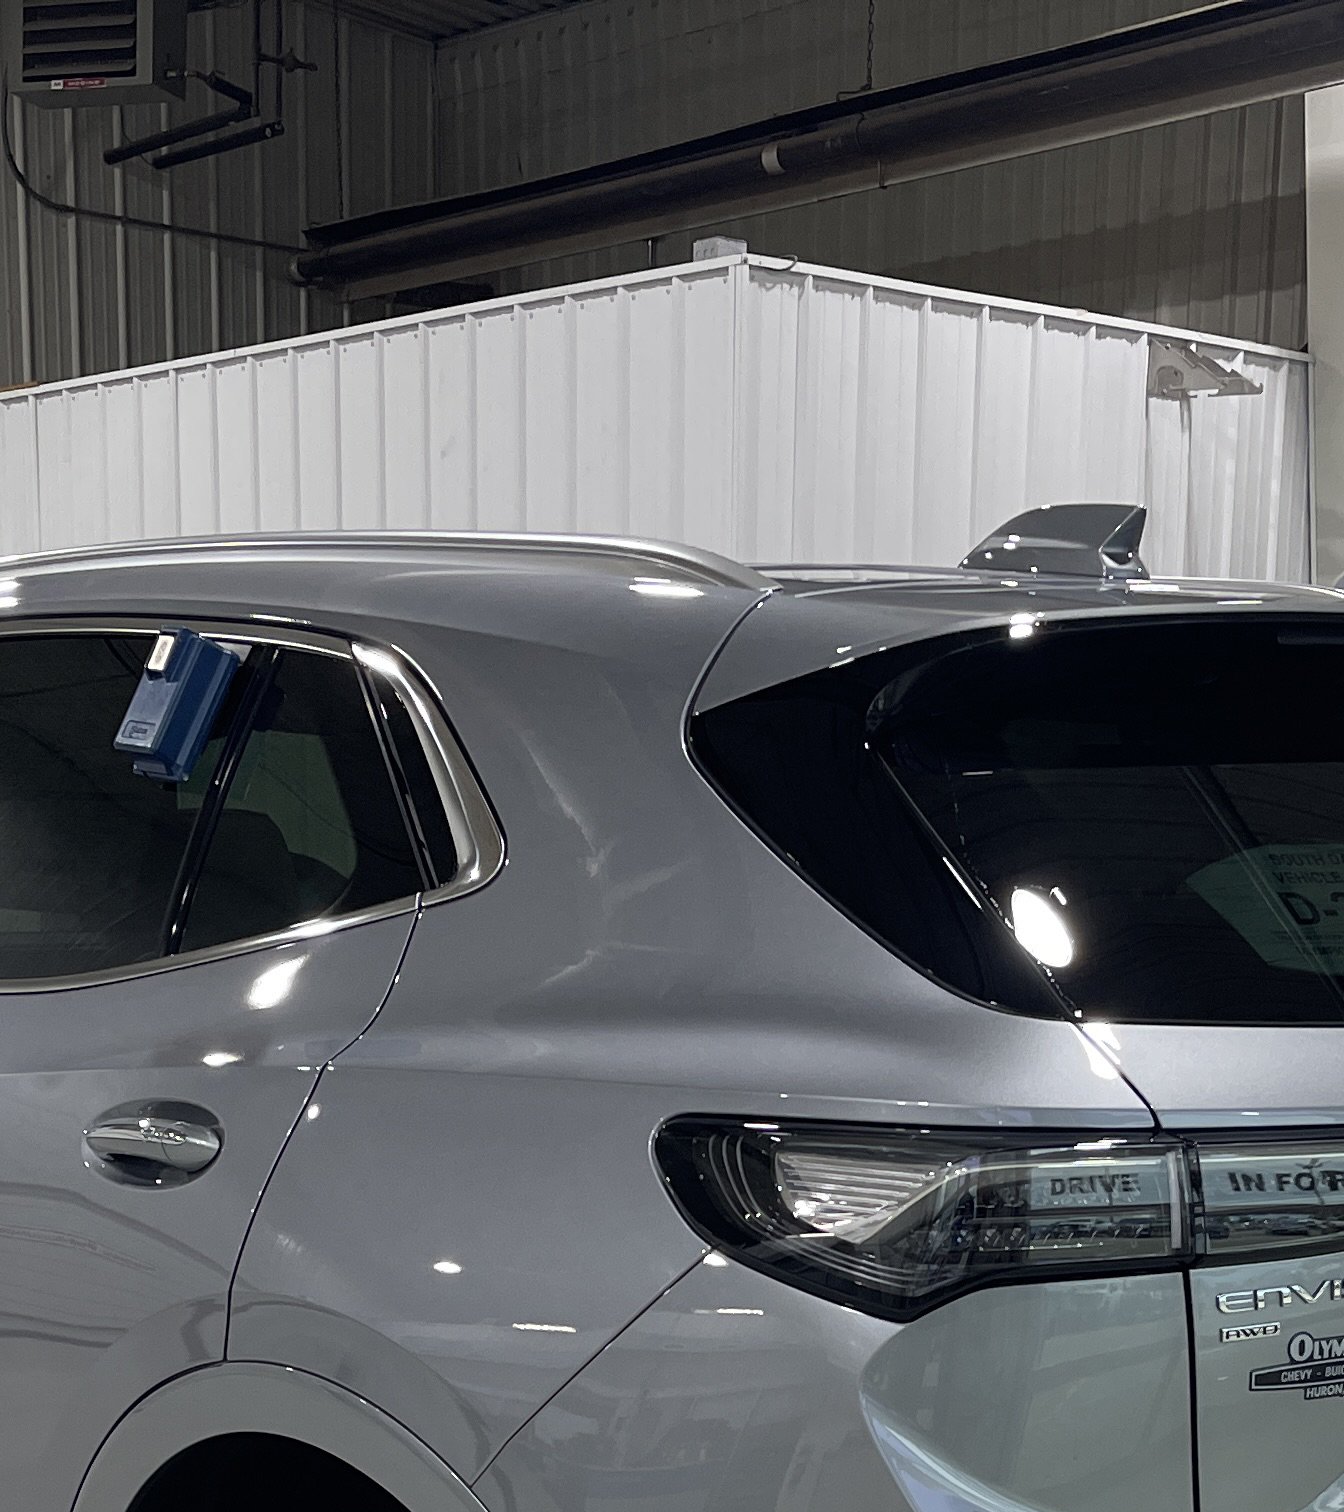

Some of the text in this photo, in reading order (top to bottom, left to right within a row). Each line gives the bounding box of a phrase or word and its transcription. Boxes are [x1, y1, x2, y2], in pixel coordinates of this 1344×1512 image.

[1272, 870, 1344, 884] VEHICLE
[1050, 1173, 1140, 1196] DRIVE
[1227, 1171, 1266, 1192] IN
[1224, 1324, 1280, 1341] AWD
[1281, 1368, 1313, 1383] CHEVY
